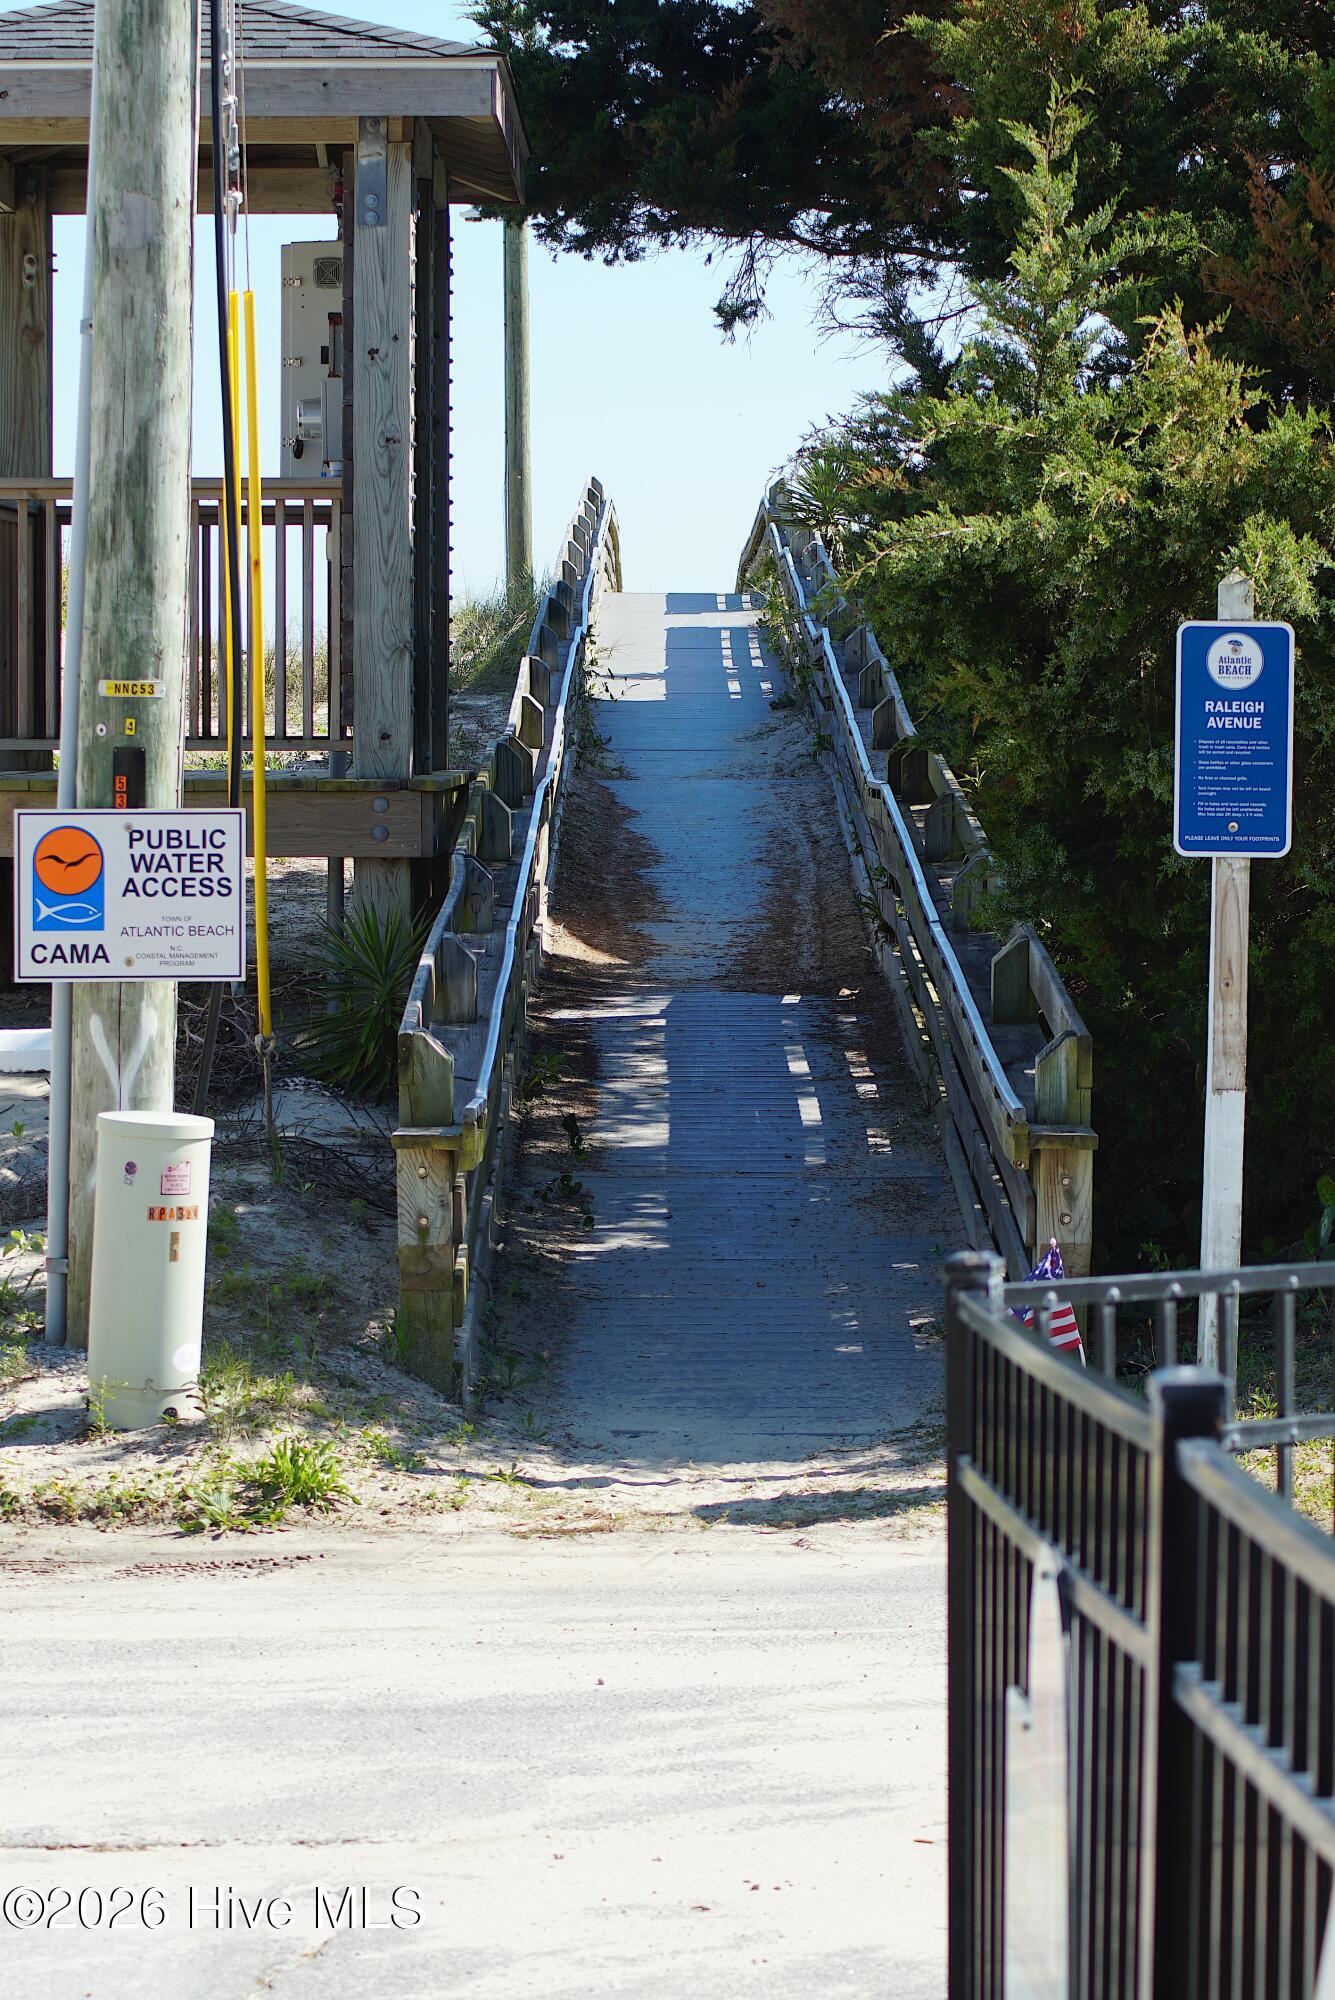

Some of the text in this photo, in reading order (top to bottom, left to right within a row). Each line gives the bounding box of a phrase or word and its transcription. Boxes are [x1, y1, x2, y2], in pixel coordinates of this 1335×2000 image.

[1218, 655, 1252, 664] Atlantic
[1218, 665, 1252, 675] BEACH
[114, 683, 155, 695] NNC53
[1205, 700, 1264, 714] RALEIGH
[126, 721, 133, 732] 4
[1206, 716, 1262, 728] AVENUE
[129, 829, 226, 850] PUBLIC
[130, 853, 224, 873] WATER
[122, 876, 232, 898] ACCESS
[120, 925, 234, 937] ATLANTIC BEACH
[30, 944, 111, 964] CAMA
